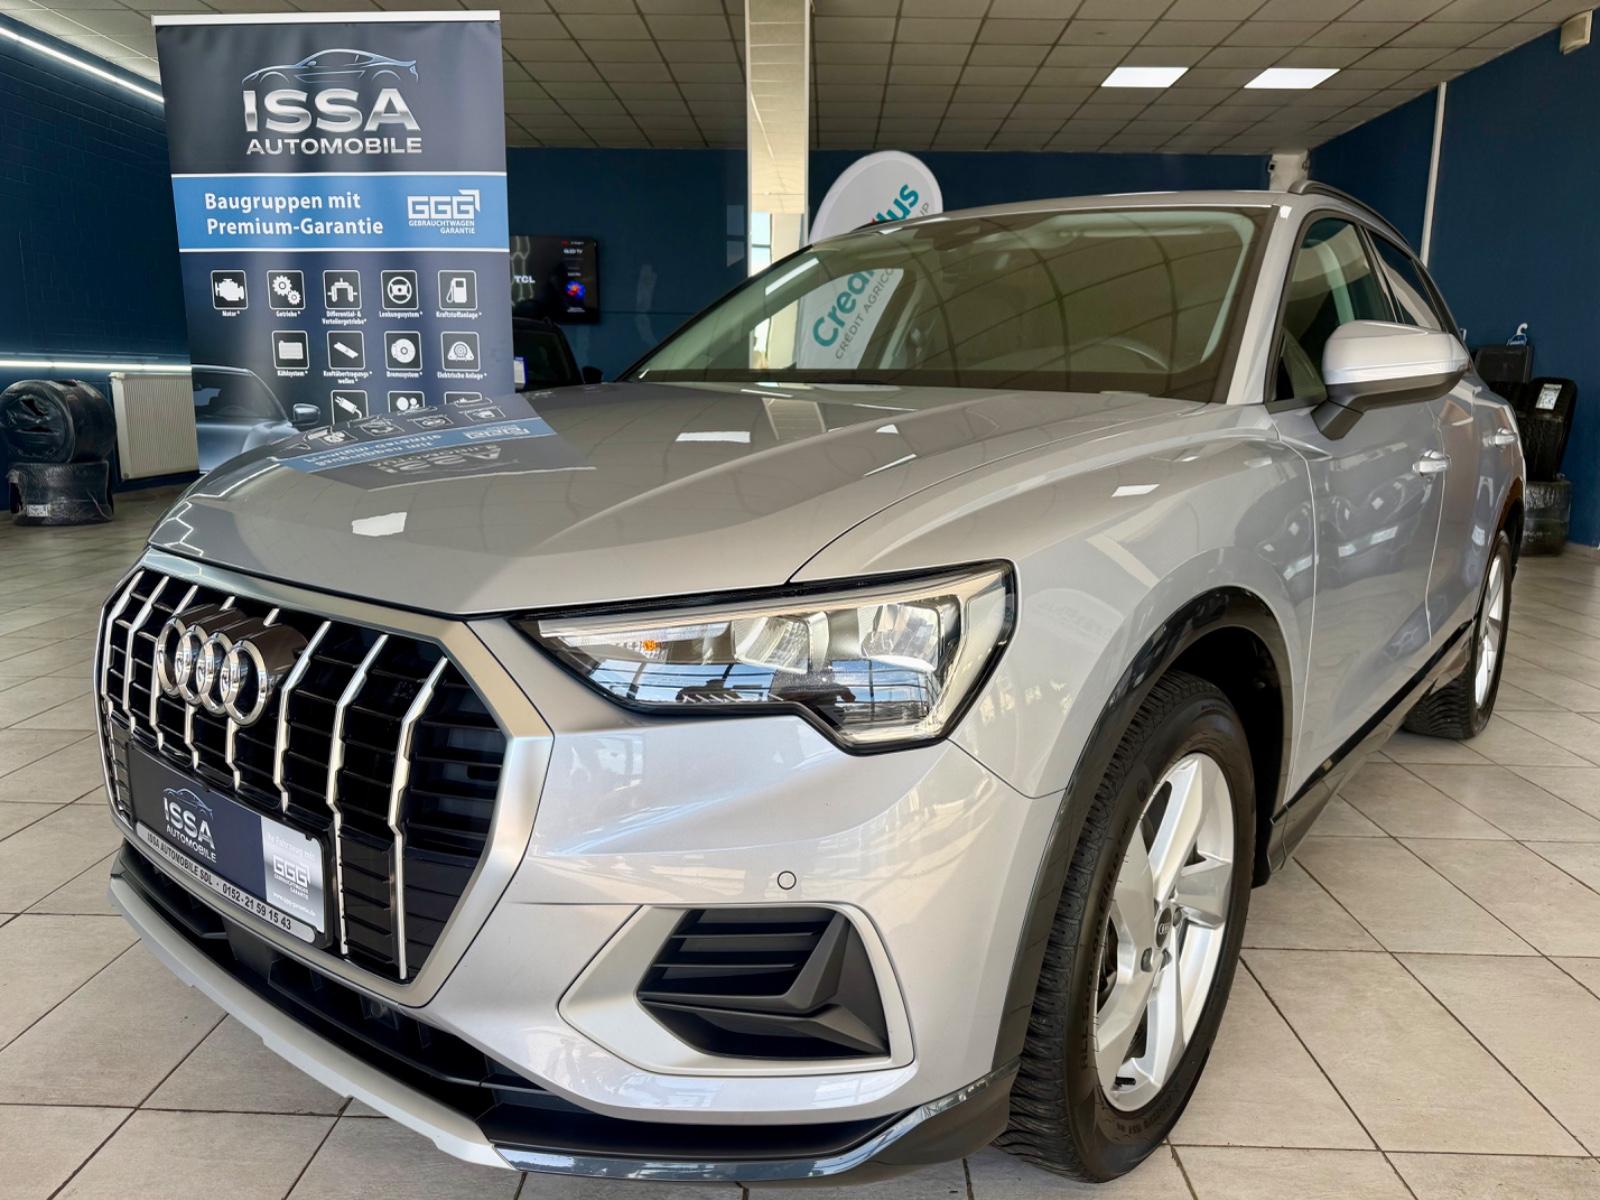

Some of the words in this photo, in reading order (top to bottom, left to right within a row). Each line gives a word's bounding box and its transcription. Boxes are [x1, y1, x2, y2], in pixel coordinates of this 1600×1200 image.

[243, 88, 420, 133] ISSA
[246, 137, 422, 155] AUTOMOBILE
[204, 192, 322, 213] Baugruppen
[328, 192, 361, 209] mit
[407, 192, 478, 219] GGG
[207, 218, 384, 236] Premium-Garantie
[514, 275, 535, 283] TCL
[164, 797, 215, 849] ISSA
[167, 824, 216, 863] AUTOMOBILE
[160, 841, 198, 876] AUTOMOBILE
[256, 903, 267, 916] 59
[268, 909, 279, 923] 15
[280, 916, 291, 930] 43
